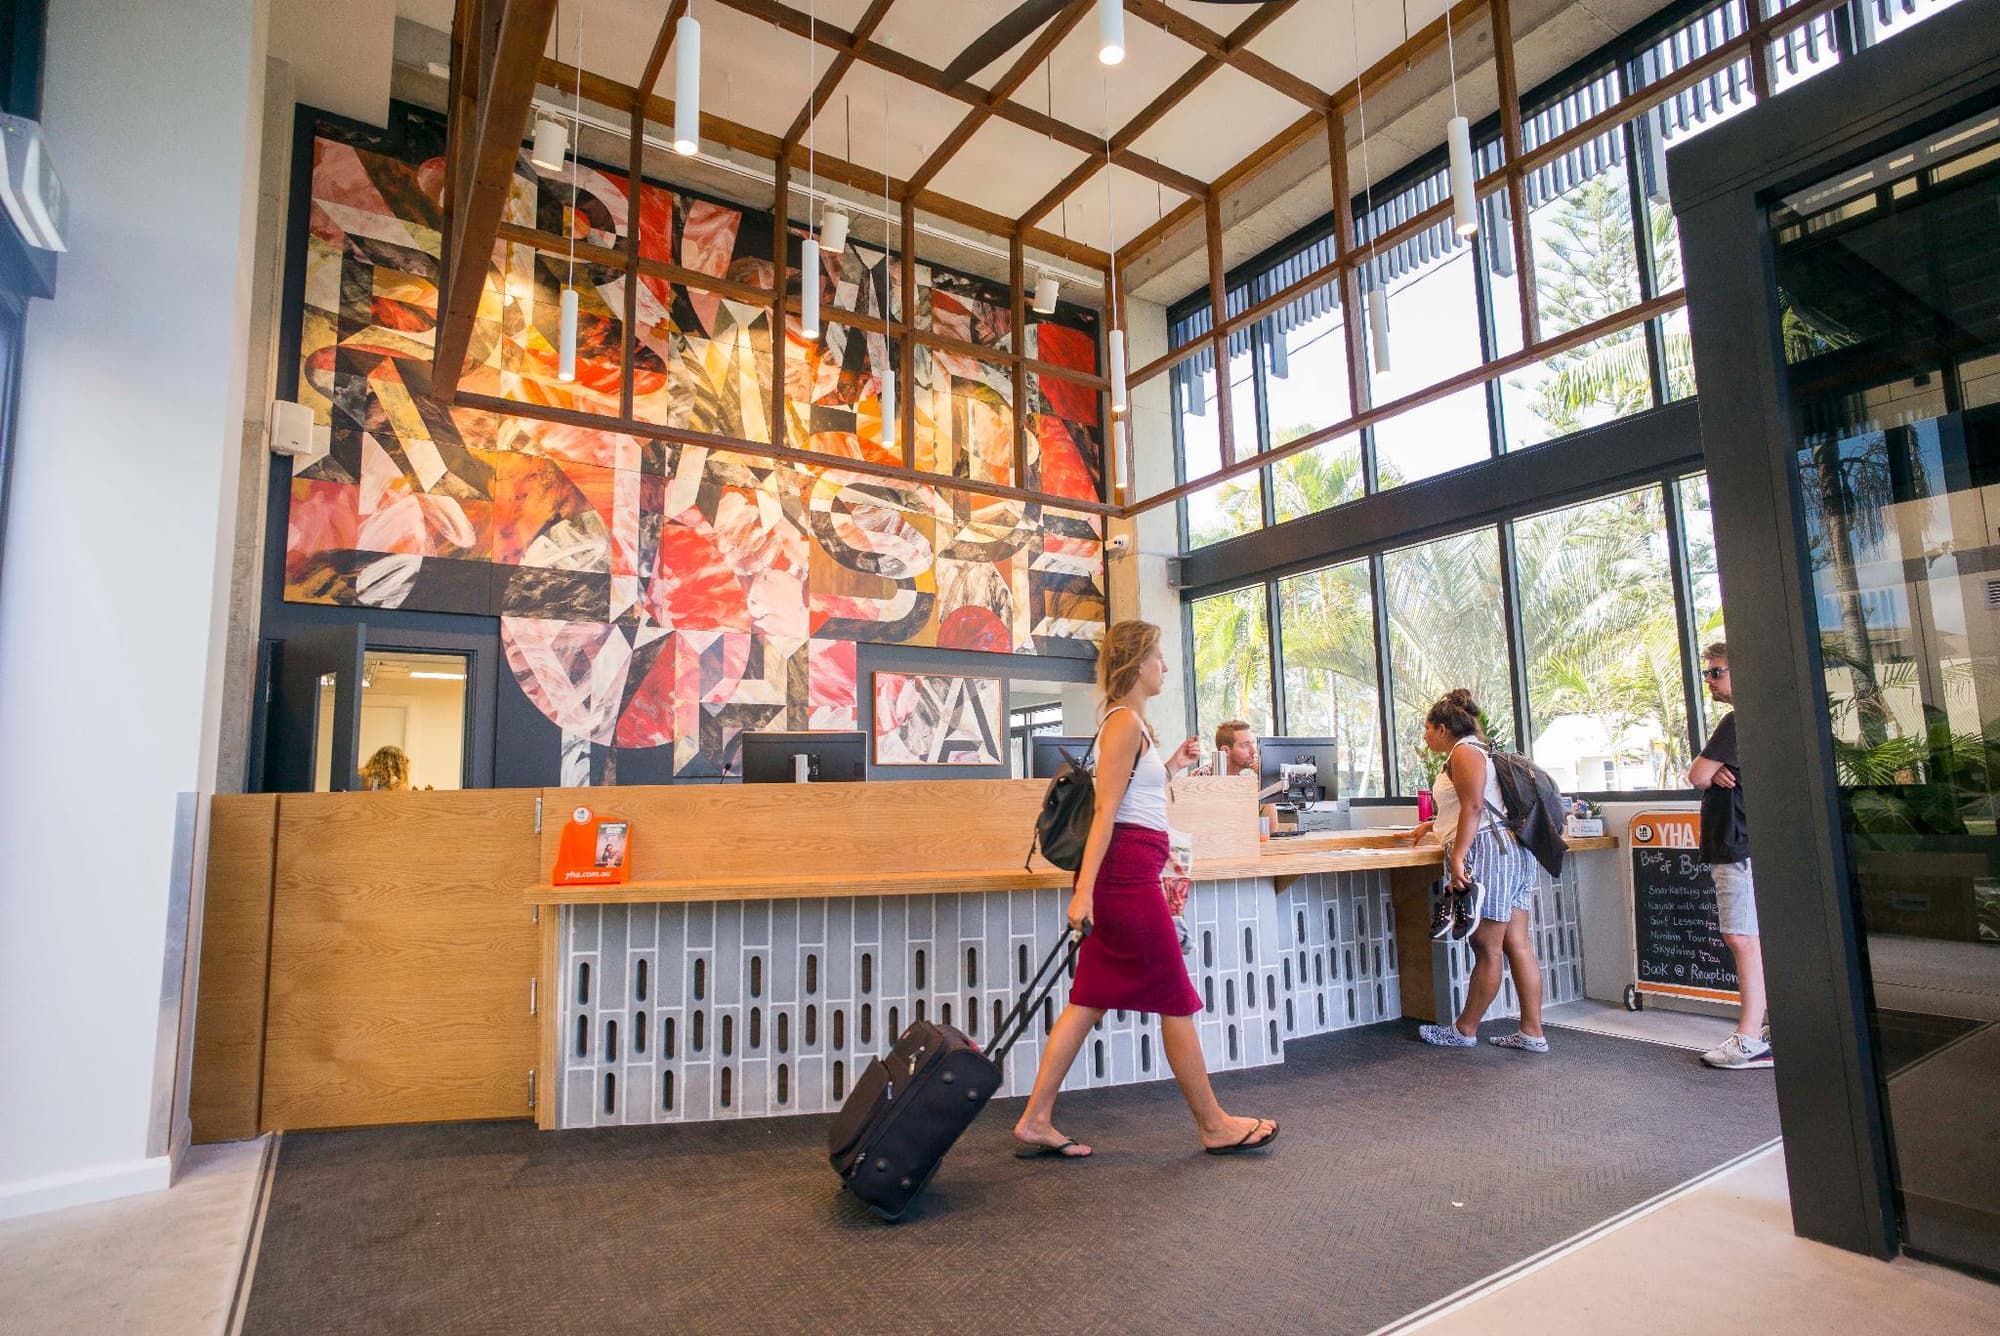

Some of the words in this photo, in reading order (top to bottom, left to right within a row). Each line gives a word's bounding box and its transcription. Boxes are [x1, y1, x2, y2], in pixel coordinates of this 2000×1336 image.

[1656, 823, 1697, 848] YHA
[1640, 850, 1664, 867] Best
[1660, 860, 1672, 875] of
[565, 871, 611, 880] yha.com.au
[1673, 916, 1704, 926] Lesson
[1686, 930, 1706, 942] Tour
[1652, 943, 1696, 959] Skydiving
[1642, 960, 1668, 976] Book
[1674, 964, 1685, 976] @
